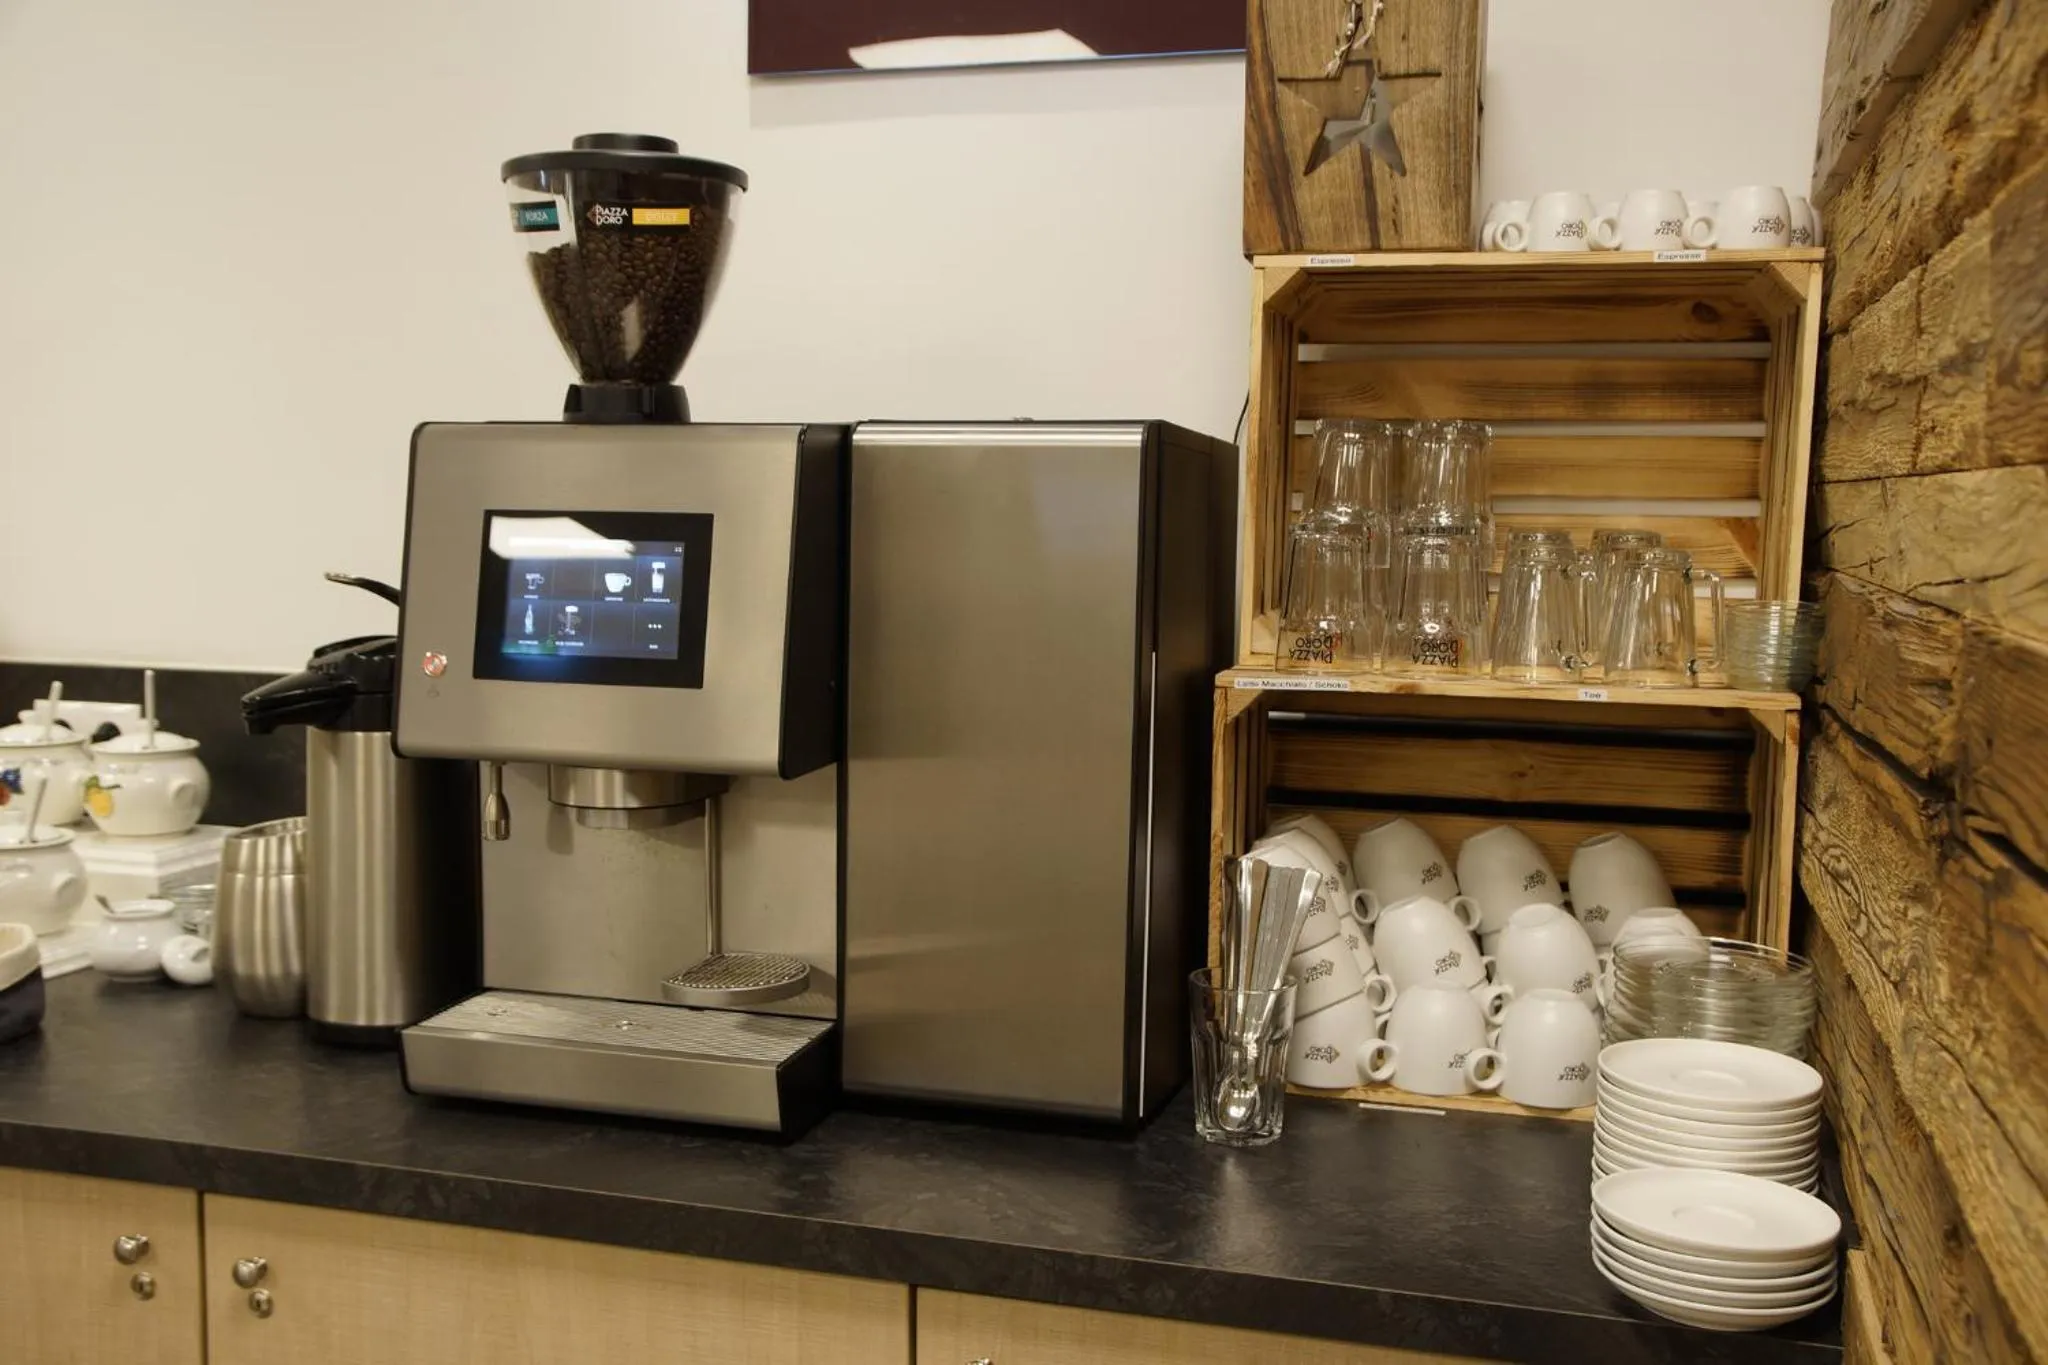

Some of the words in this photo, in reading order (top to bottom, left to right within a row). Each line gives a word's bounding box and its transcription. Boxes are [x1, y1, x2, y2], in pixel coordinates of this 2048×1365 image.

[595, 204, 628, 217] PIAZZA
[595, 214, 624, 226] DORO
[1296, 635, 1333, 648] DORO
[1420, 639, 1459, 653] DORO
[1288, 648, 1333, 664] PIAZZA
[1412, 654, 1459, 668] PIAZZA
